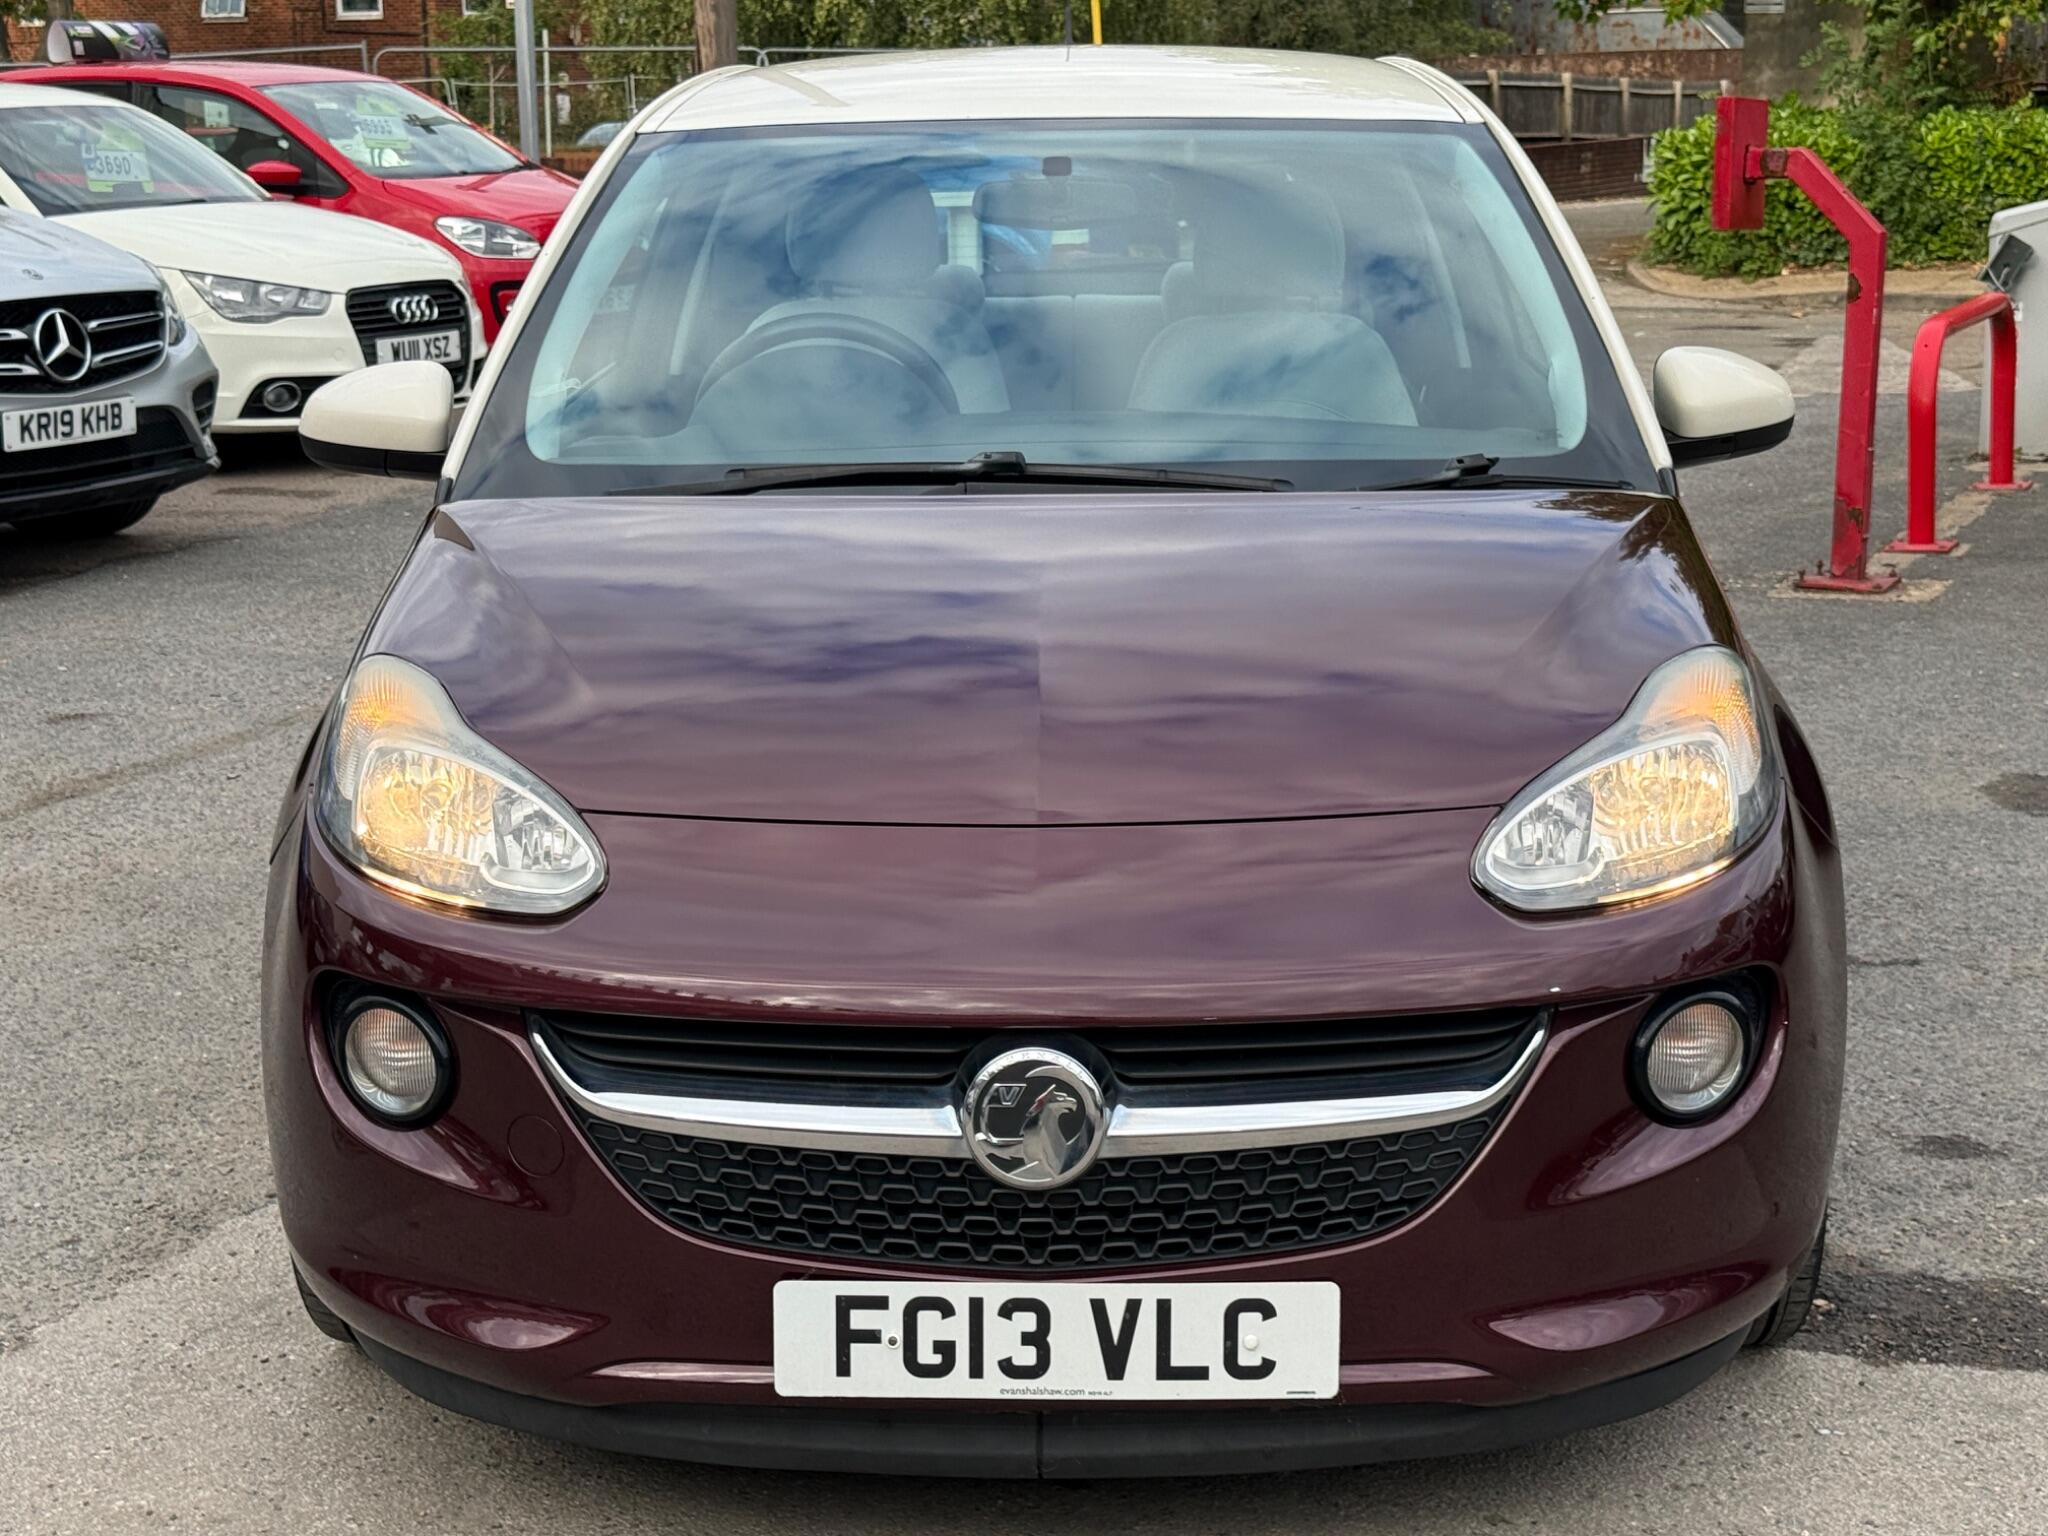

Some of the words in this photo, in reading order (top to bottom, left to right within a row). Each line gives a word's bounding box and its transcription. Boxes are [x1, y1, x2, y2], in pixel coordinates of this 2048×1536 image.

[391, 338, 420, 361] WU11
[424, 336, 451, 359] XSZ
[19, 409, 74, 444] KR19
[81, 402, 123, 436] KHB
[835, 1295, 1051, 1380] FG13
[1089, 1297, 1278, 1381] VLC
[999, 1386, 1085, 1396] evanshalshaw.com
